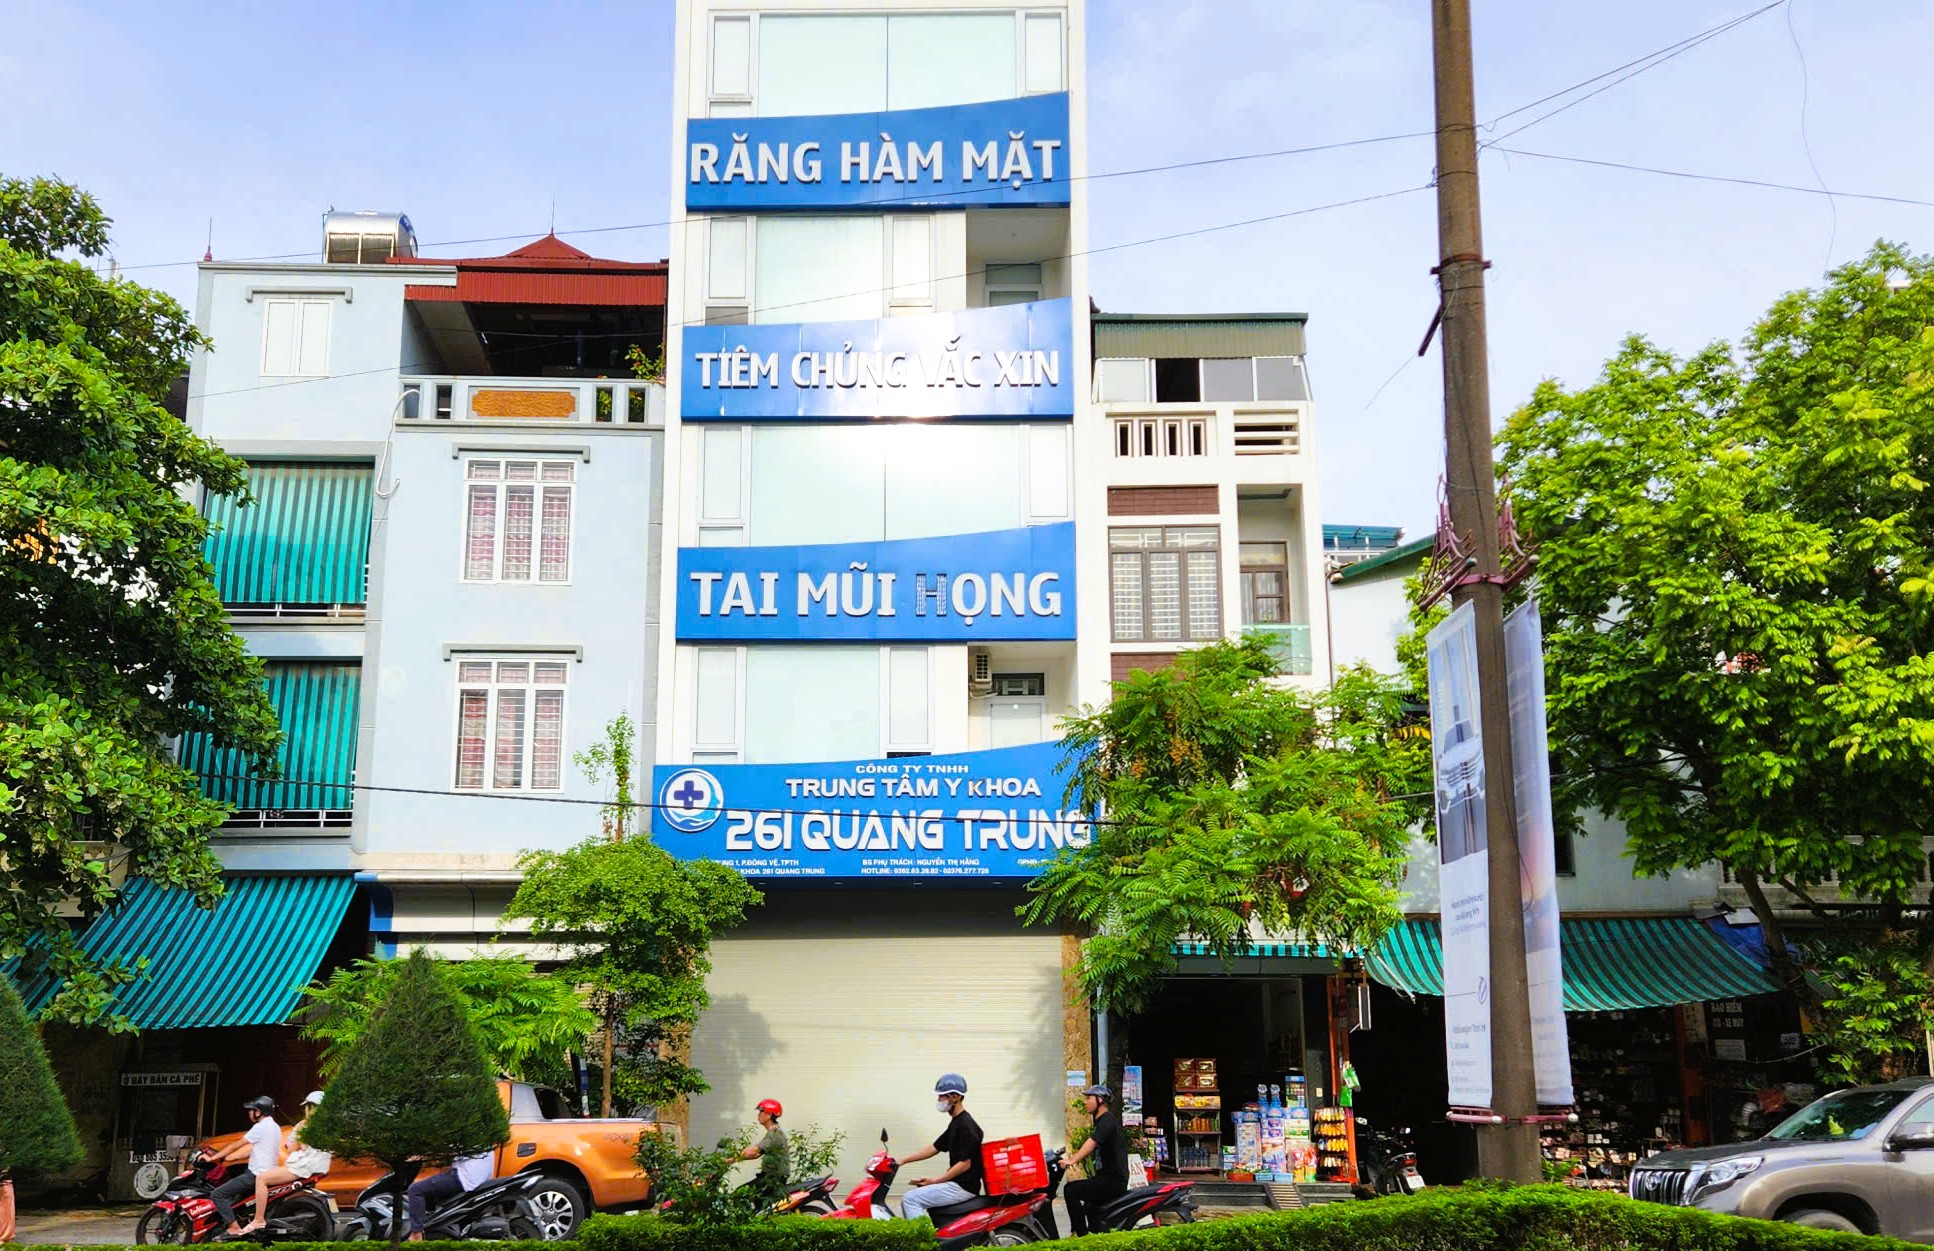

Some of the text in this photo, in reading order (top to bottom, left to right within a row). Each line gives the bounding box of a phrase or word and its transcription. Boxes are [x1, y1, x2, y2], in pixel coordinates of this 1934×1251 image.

[690, 130, 1062, 190] RĂNG HÀM MẶT
[695, 335, 1059, 389] TIÊM CHỦNG VẮC XIN
[690, 561, 1062, 626] TAI MŨI HỌNG
[785, 773, 1042, 798] TRUNG TÂM Y KHOA
[855, 762, 969, 774] CÔNG TY TNHH
[726, 810, 1092, 850] 261 QUANG TRUNG
